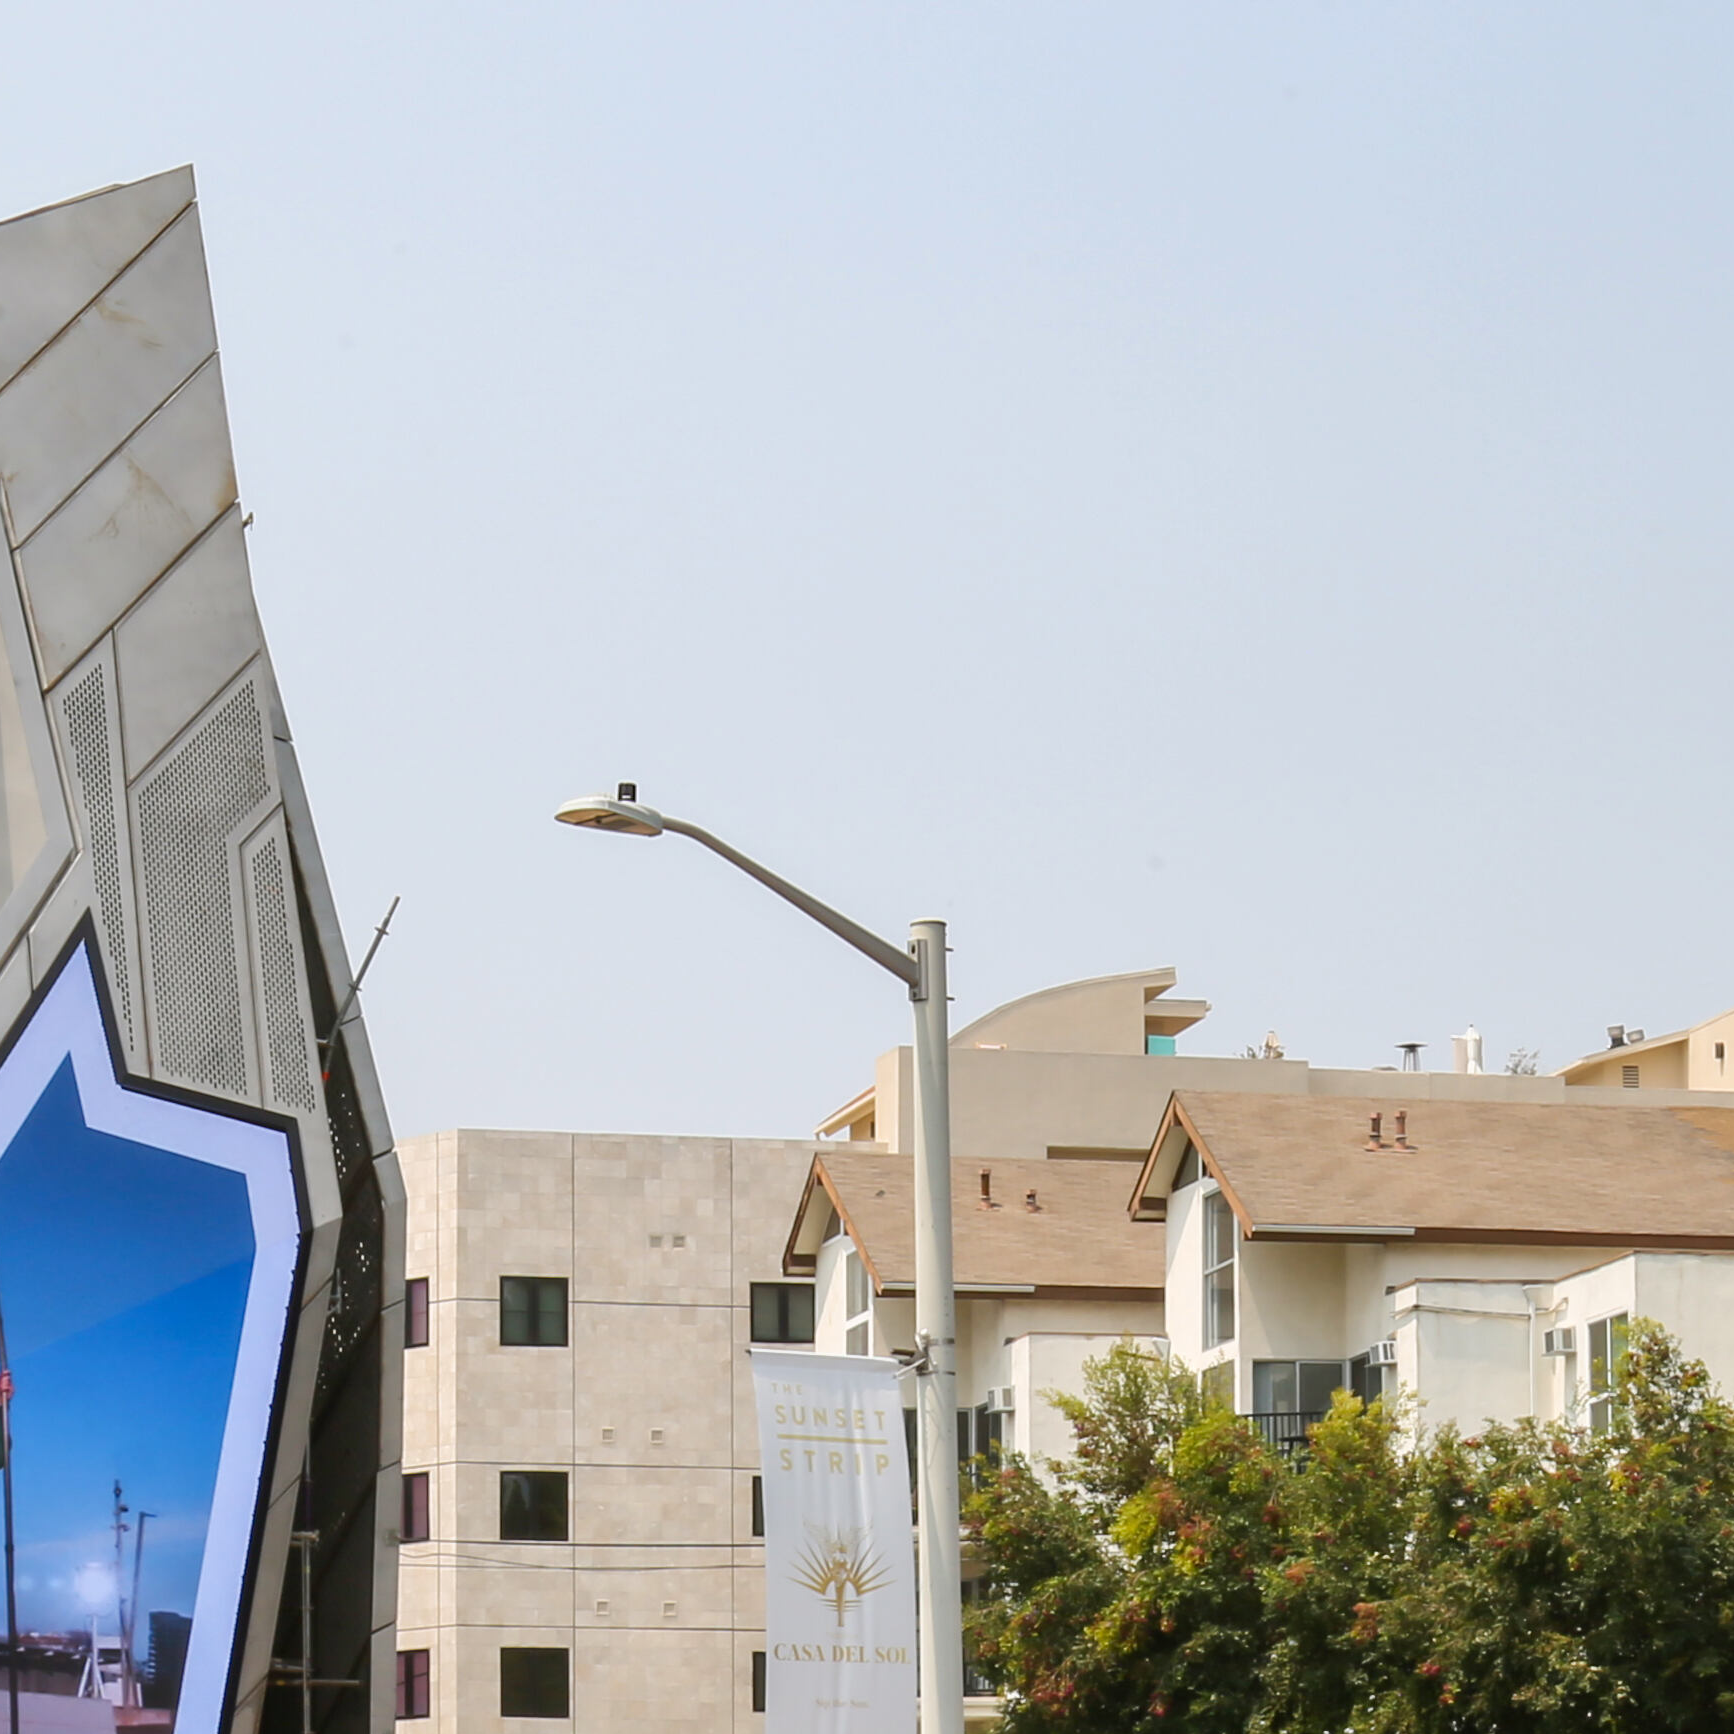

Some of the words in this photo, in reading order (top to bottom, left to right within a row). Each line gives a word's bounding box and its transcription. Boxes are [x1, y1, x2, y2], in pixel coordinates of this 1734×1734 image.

[771, 1382, 803, 1396] THE
[774, 1404, 886, 1431] SUNSET
[779, 1448, 890, 1476] STRIP
[773, 1643, 826, 1662] CASA
[832, 1645, 871, 1664] DEL
[874, 1646, 912, 1665] SOL
